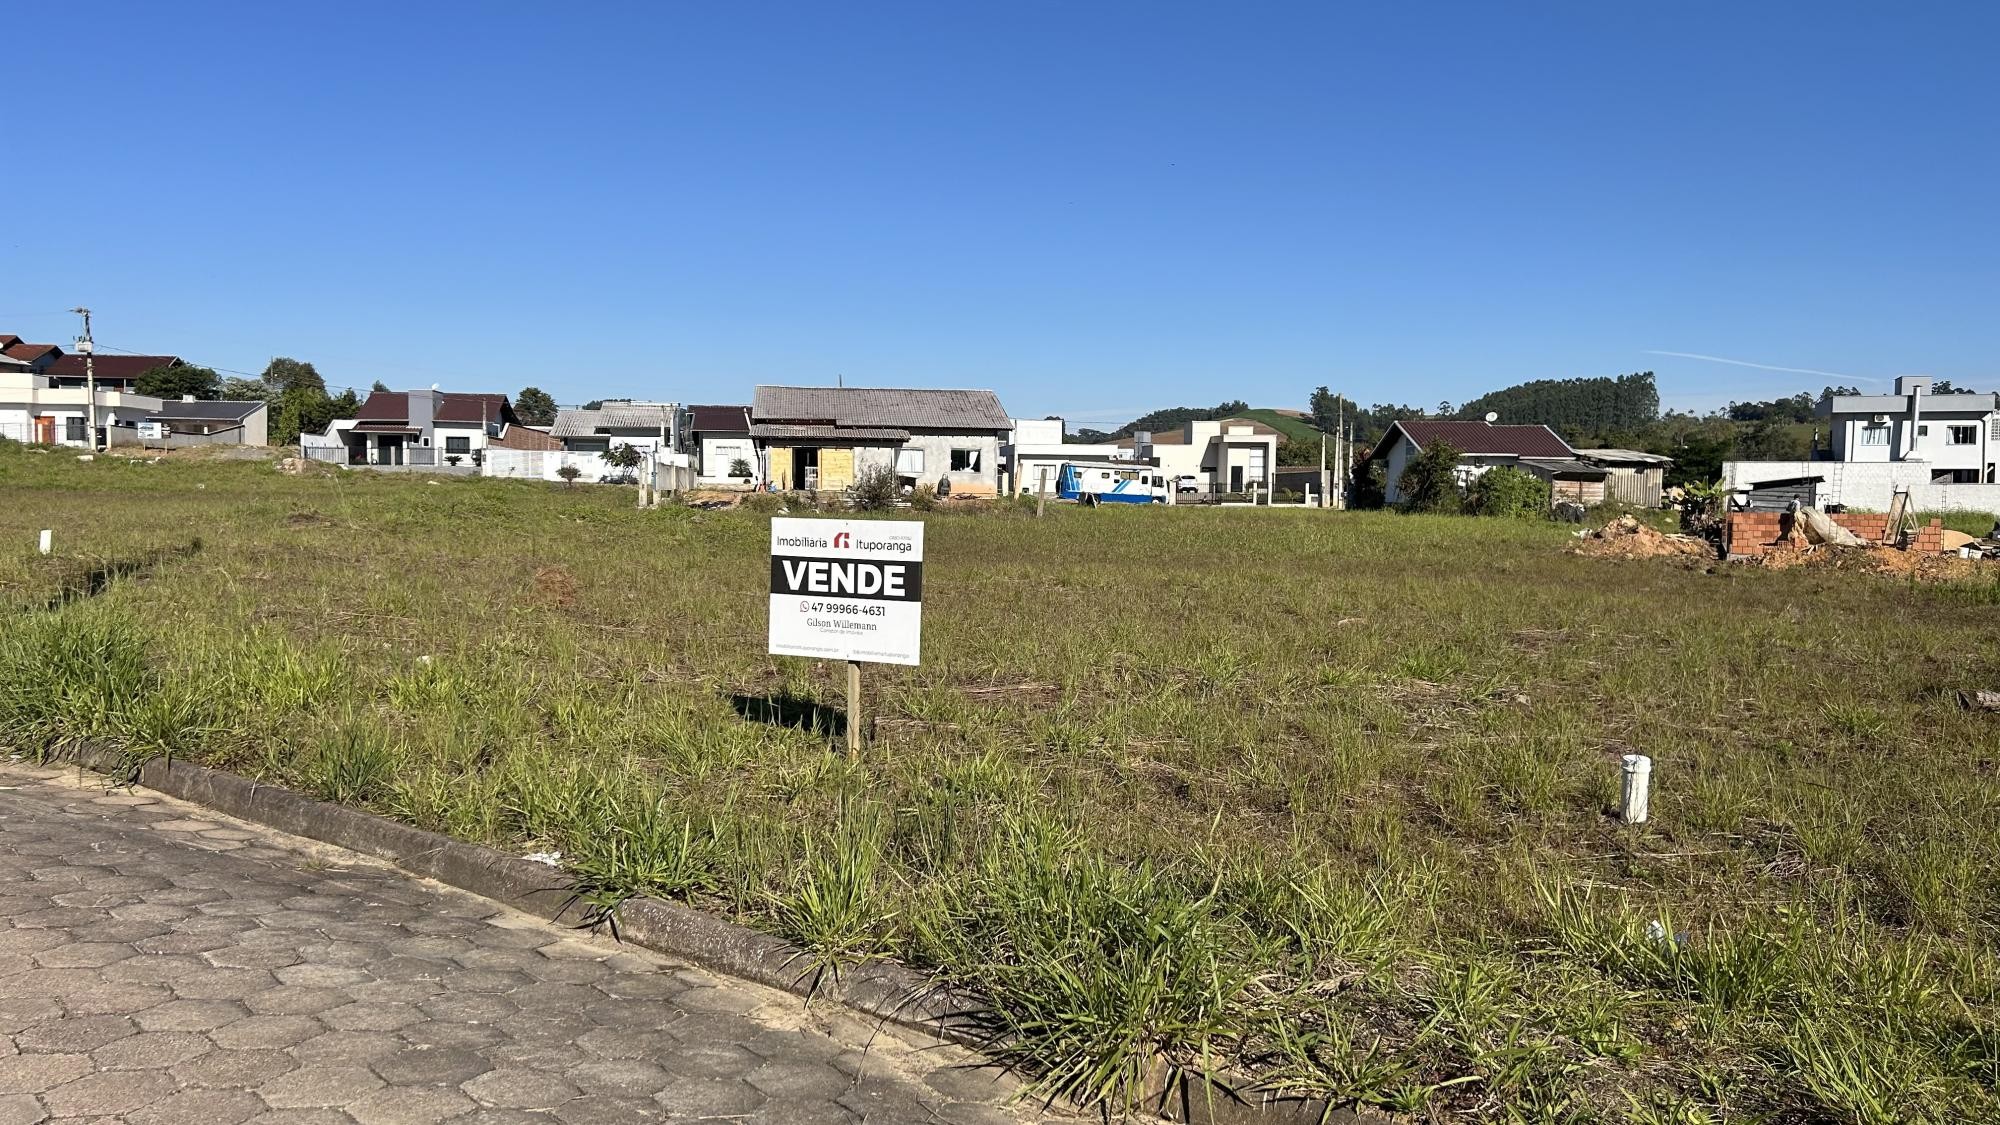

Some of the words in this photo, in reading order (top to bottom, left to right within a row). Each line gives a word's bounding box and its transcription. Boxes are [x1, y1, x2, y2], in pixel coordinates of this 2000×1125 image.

[856, 539, 912, 553] Ituporanga
[781, 559, 906, 597] VENDE
[811, 602, 824, 613] 47
[826, 604, 886, 617] 99966-4631
[806, 618, 831, 628] Gilson
[833, 619, 877, 631] Willemann
